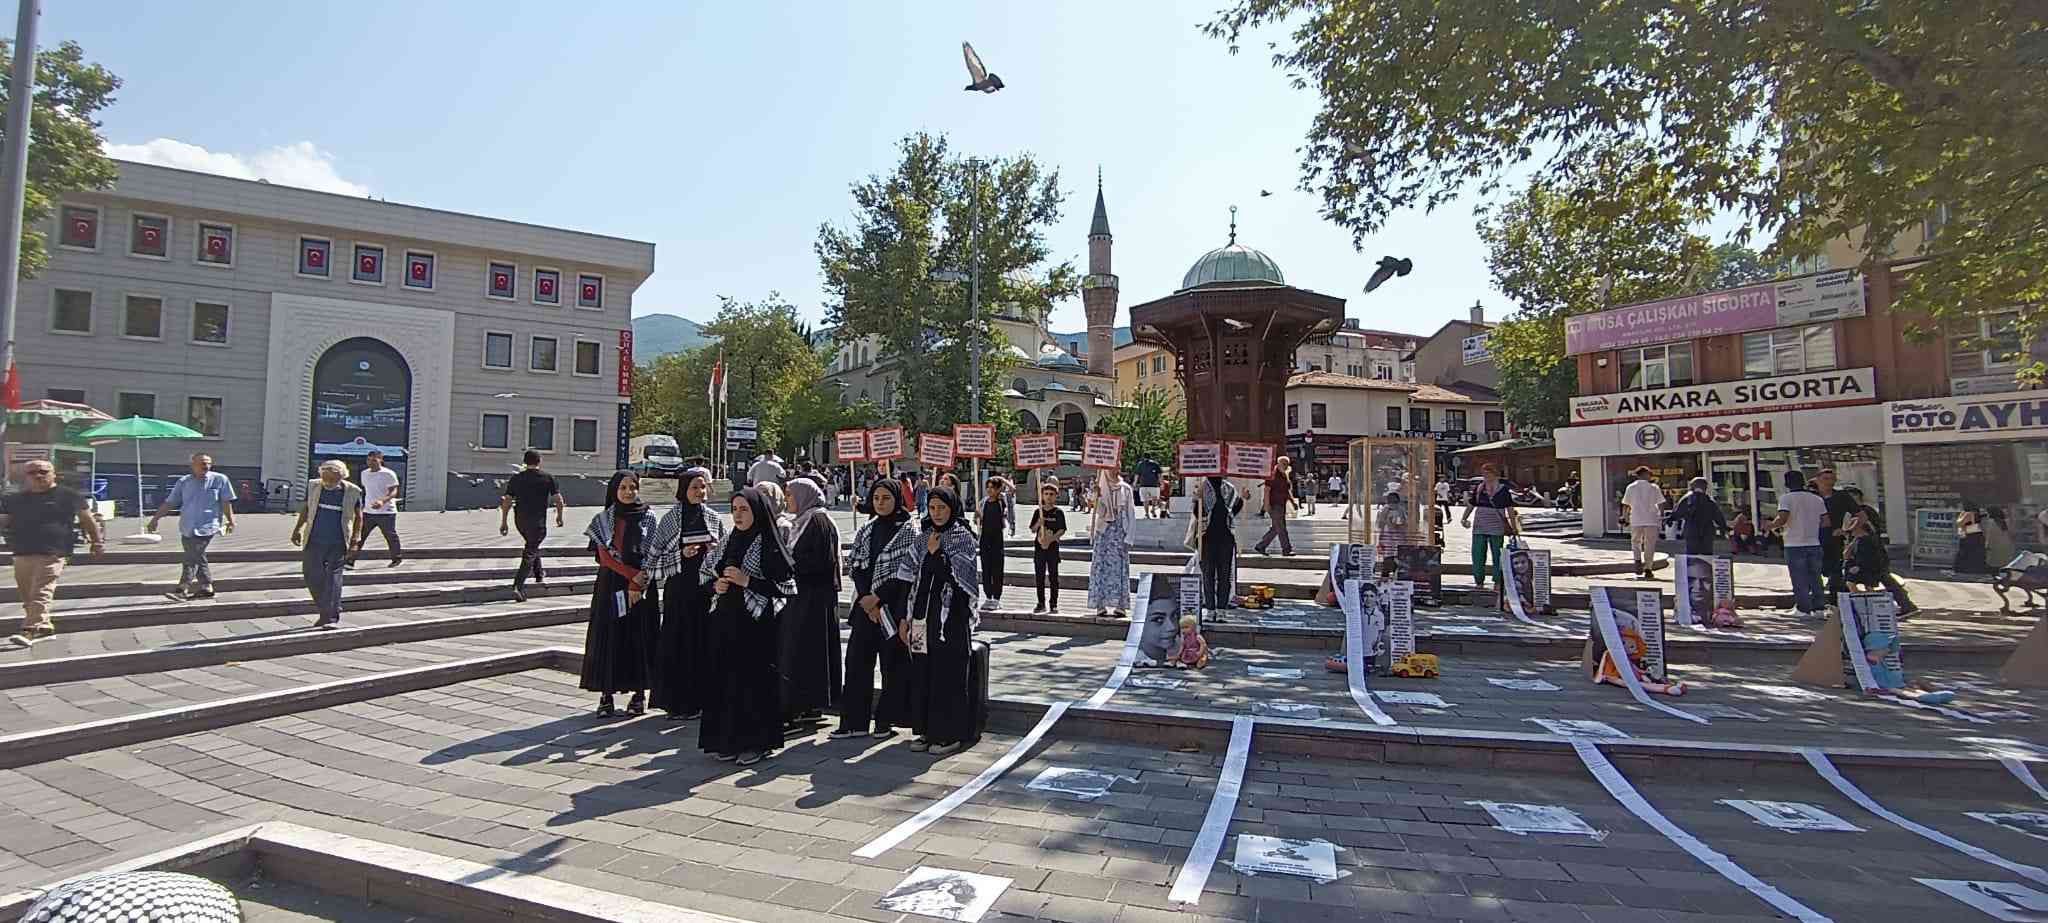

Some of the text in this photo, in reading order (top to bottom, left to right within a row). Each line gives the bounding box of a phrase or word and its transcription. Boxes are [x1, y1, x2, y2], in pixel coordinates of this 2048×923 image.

[1586, 311, 1624, 333] MUSA
[1627, 302, 1697, 332] ÇALIŞKAN
[1617, 375, 1861, 414] ANKARA SİGORTA
[1892, 411, 1956, 427] FOTO
[1677, 421, 1772, 445] BOSCH
